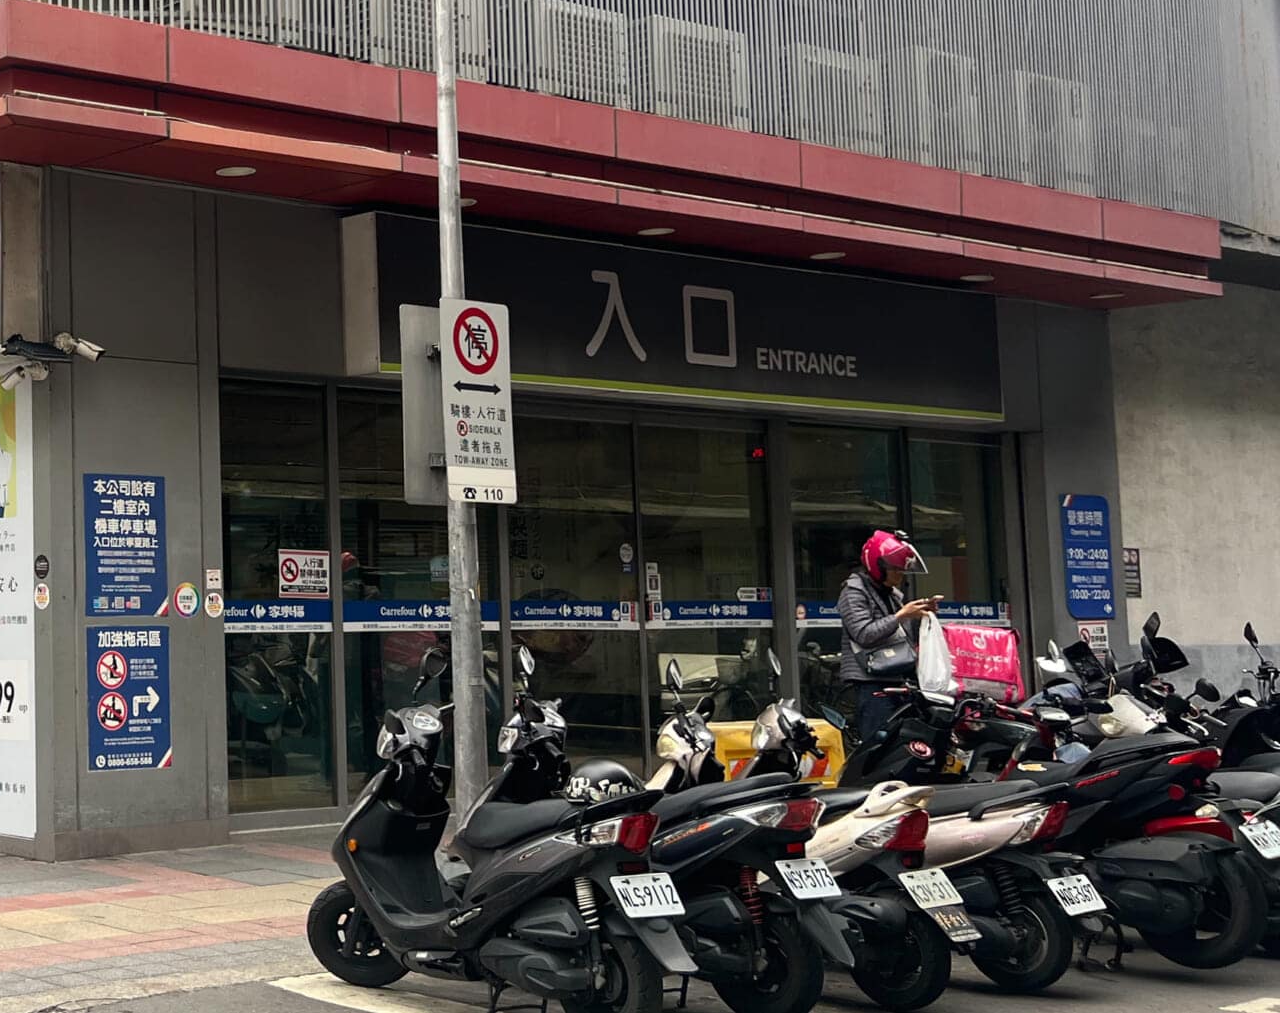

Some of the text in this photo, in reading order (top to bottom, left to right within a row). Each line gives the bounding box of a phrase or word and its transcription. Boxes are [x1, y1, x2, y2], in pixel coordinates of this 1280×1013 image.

[586, 270, 858, 377] 入口 ENTRANCE
[464, 324, 488, 360] 停
[468, 424, 503, 436] SIDEWALK
[491, 457, 509, 467] ZONE
[93, 479, 156, 497] 本公司設有
[484, 488, 503, 502] 110
[223, 607, 248, 618] refour
[380, 606, 417, 617] Carrefour
[524, 605, 558, 616] Carrefour
[617, 884, 679, 908] NLS-9112
